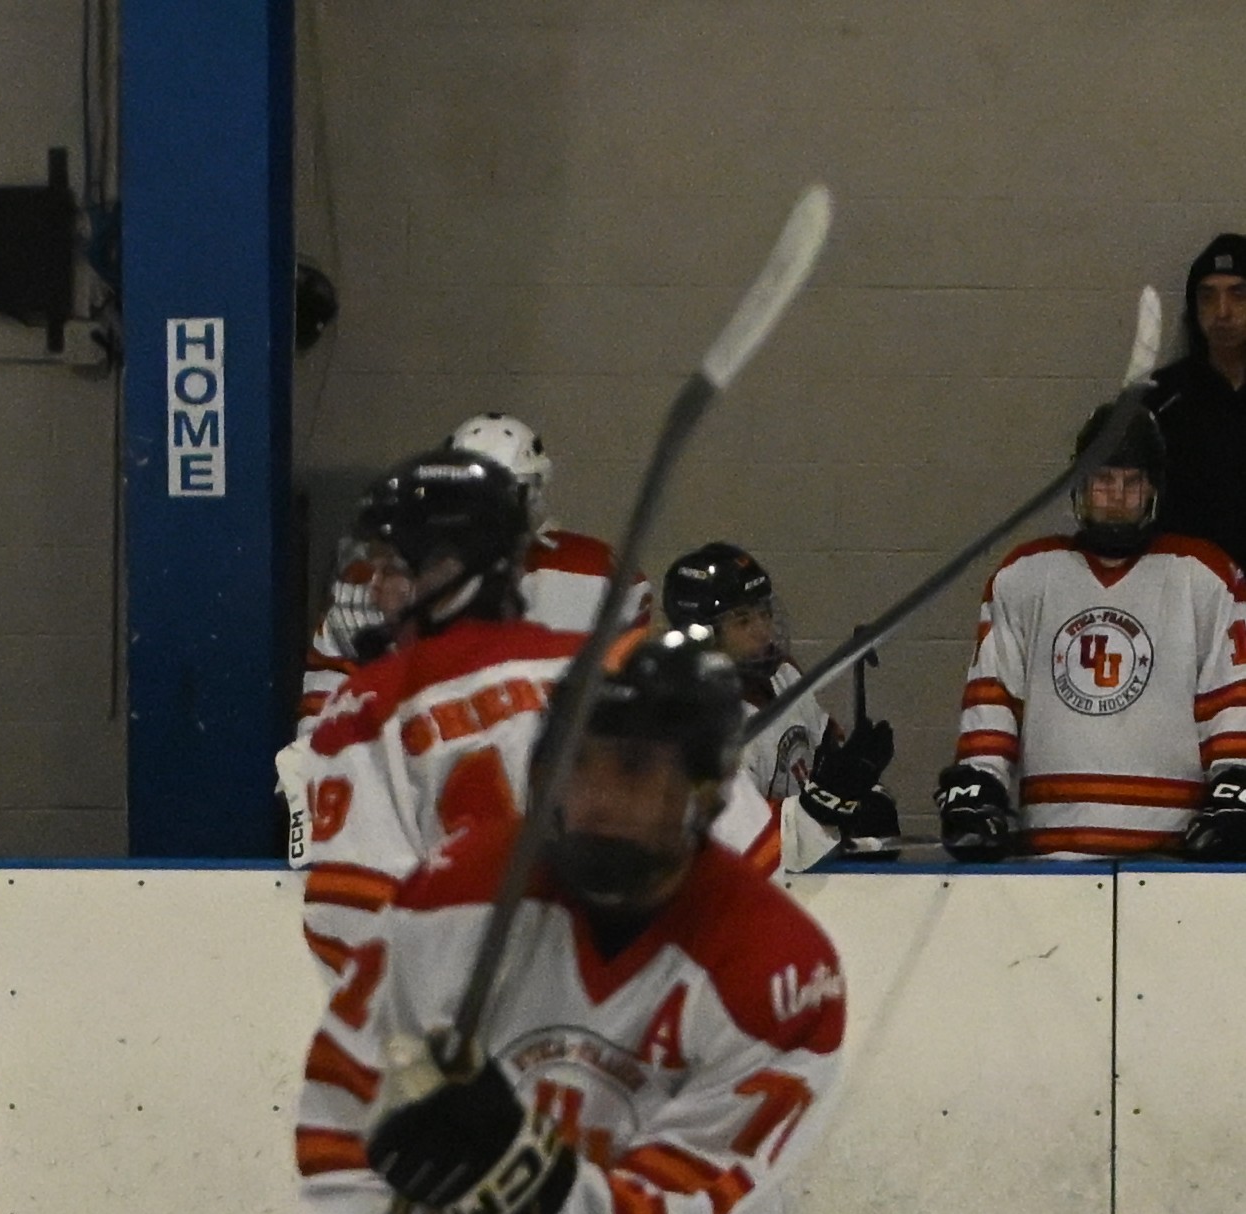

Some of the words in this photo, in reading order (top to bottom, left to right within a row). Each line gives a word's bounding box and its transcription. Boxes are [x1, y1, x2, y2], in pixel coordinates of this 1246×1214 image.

[173, 323, 219, 491] HOME
[1056, 673, 1094, 711] UNIFIED
[1098, 674, 1144, 713] HOCKEY
[290, 808, 305, 860] CCM
[638, 980, 690, 1070] A
